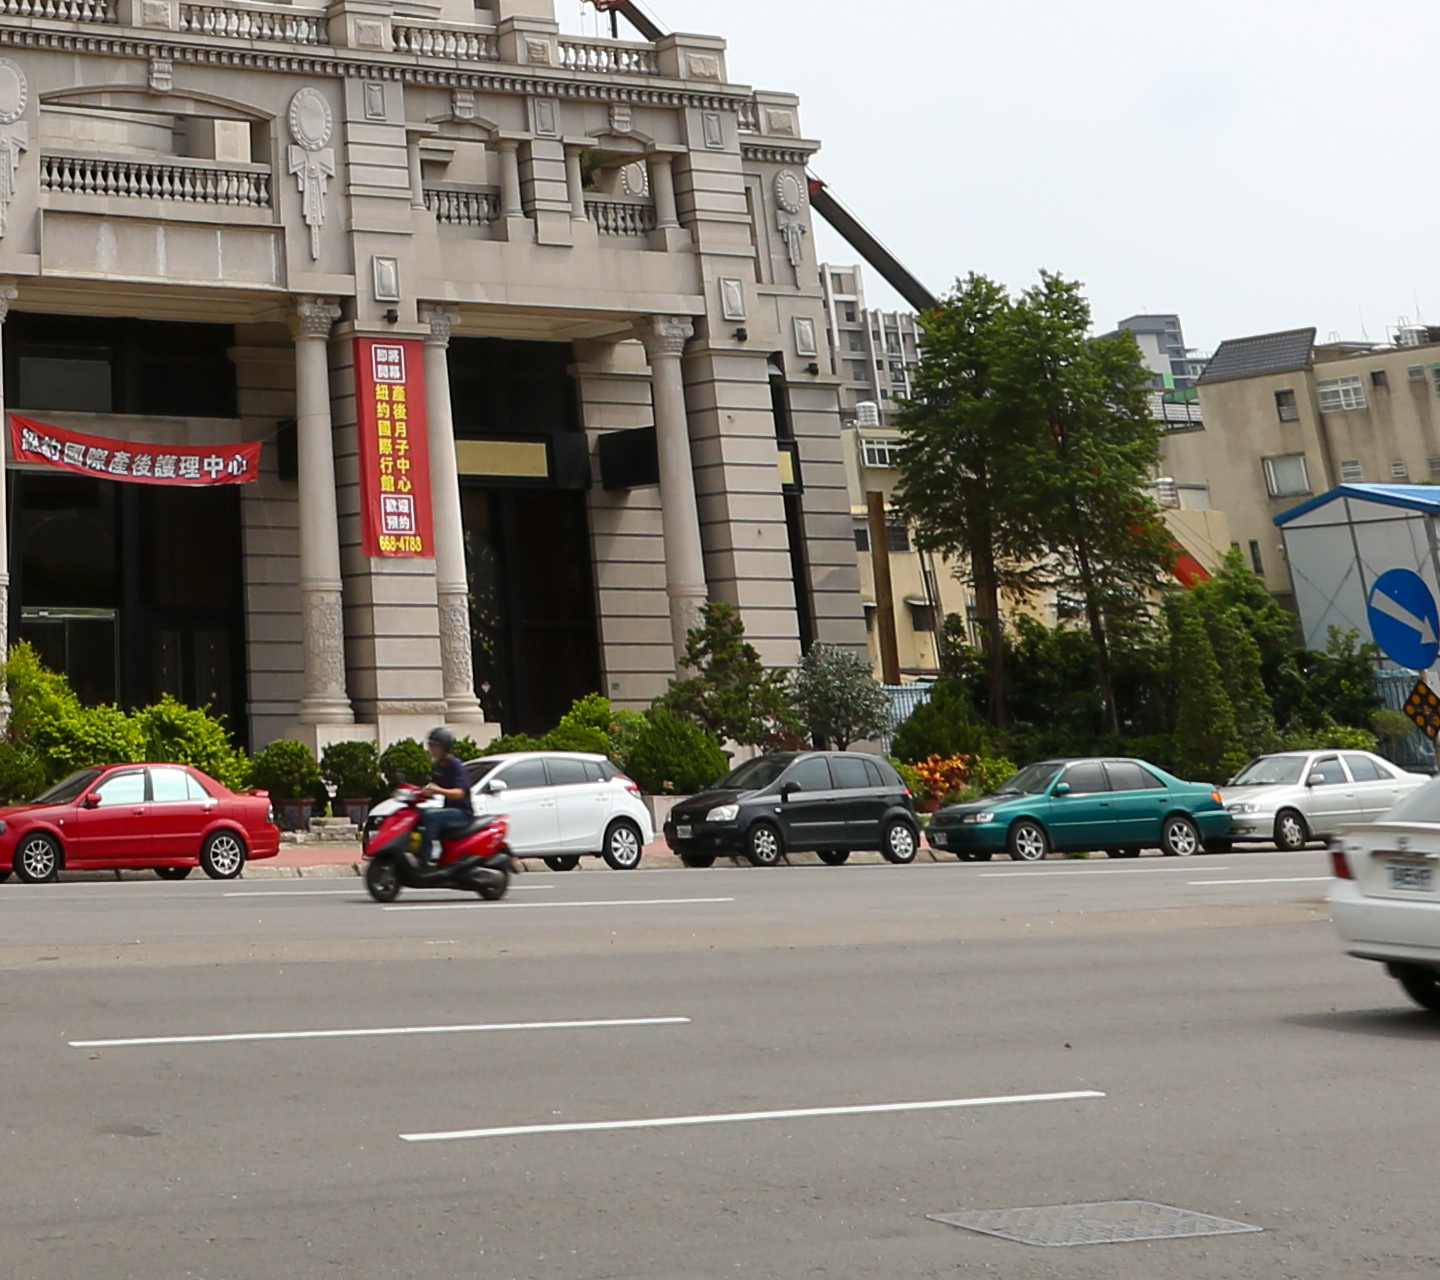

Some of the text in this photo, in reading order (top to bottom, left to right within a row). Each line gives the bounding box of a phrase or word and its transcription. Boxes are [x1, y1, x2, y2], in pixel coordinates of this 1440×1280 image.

[391, 384, 413, 493] 產後月子中心
